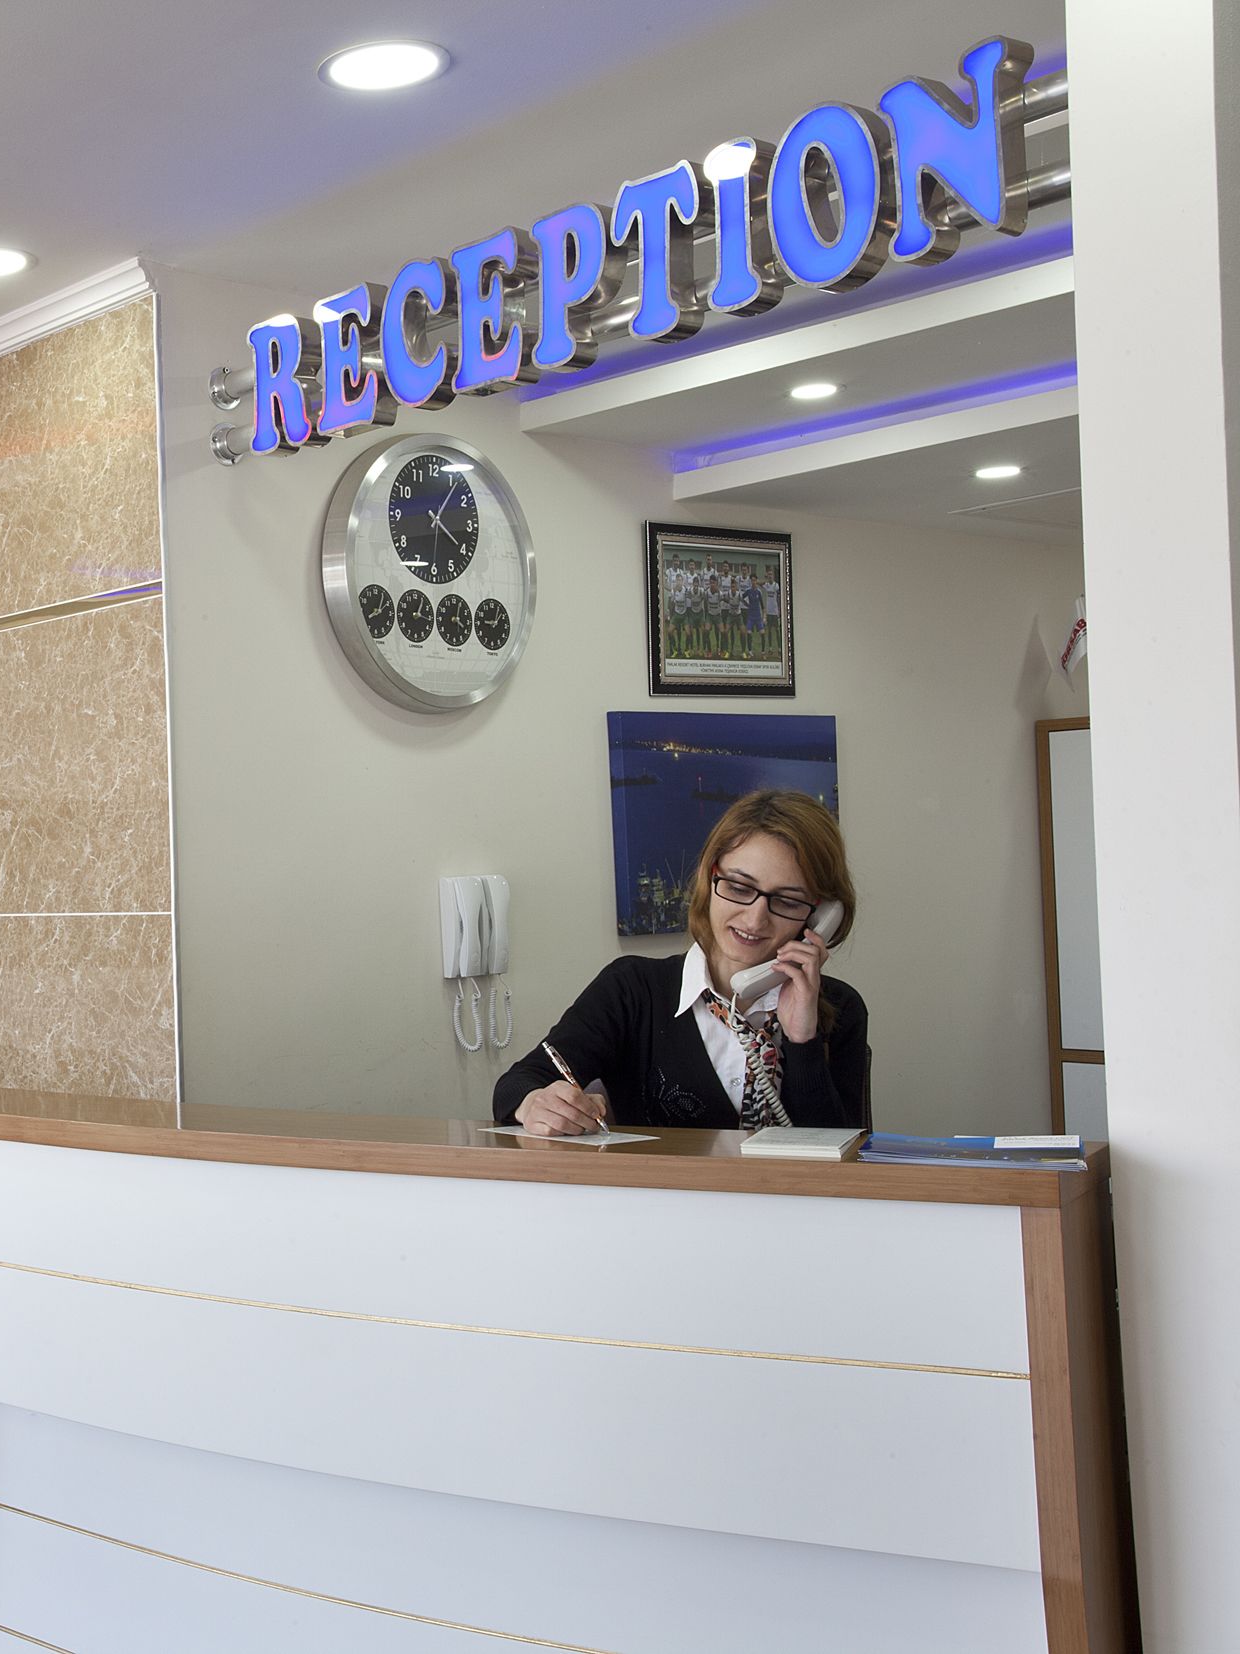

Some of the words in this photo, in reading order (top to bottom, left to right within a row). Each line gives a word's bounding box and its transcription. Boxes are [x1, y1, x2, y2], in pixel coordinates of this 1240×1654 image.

[248, 34, 1010, 456] RECEPTION
[412, 469, 423, 482] 11
[428, 464, 439, 477] 12
[448, 474, 453, 487] 1
[399, 485, 411, 499] 10
[460, 495, 468, 508] 2
[394, 509, 402, 521] 9
[466, 520, 473, 532] 3
[400, 535, 407, 548] 8
[460, 544, 466, 555] 4
[430, 562, 438, 575] 6
[448, 560, 454, 572] 5
